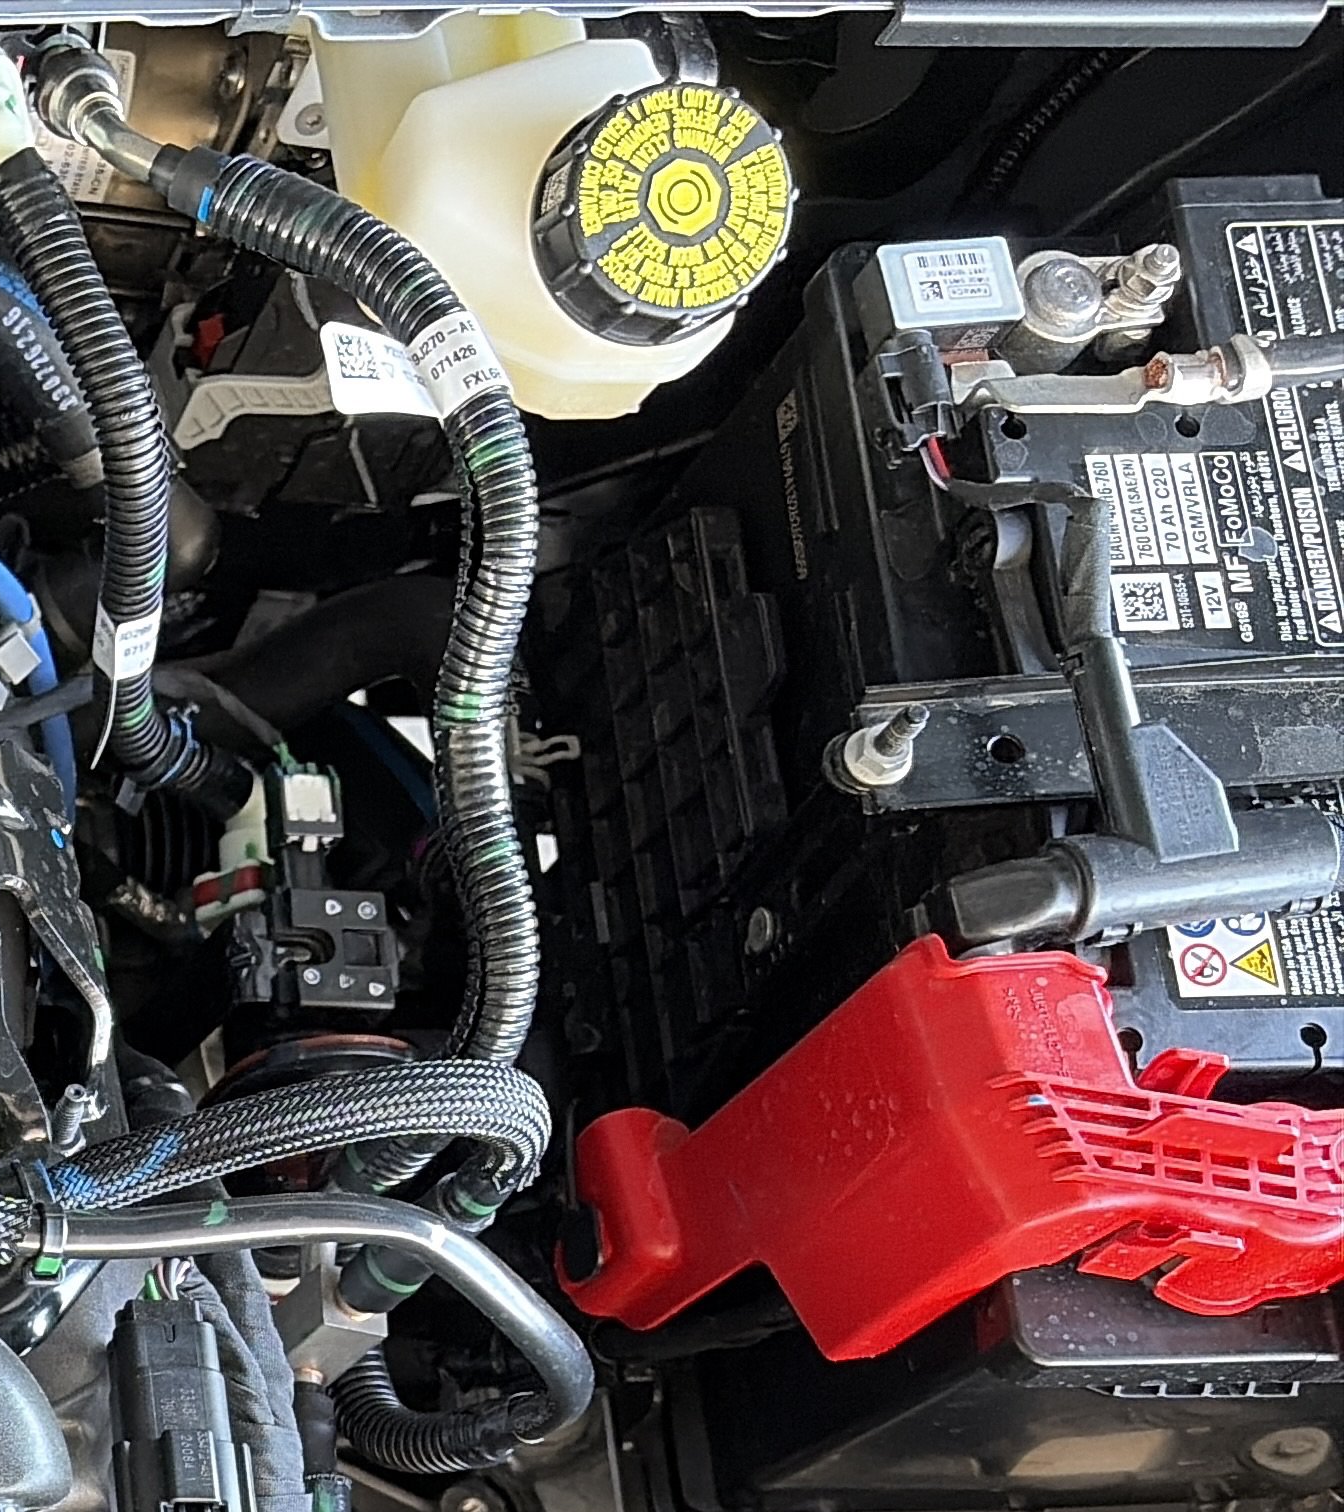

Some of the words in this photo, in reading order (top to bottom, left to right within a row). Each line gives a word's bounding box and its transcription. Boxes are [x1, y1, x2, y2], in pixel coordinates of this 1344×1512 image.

[641, 90, 678, 115] FROM
[682, 88, 720, 113] FLUID
[629, 133, 670, 172] CLEAN
[603, 159, 626, 187] USE
[430, 344, 477, 380] 071426
[1120, 459, 1141, 503] (SAE/EN)
[1154, 467, 1170, 498] C20
[1260, 480, 1274, 493] MI
[1178, 462, 1211, 555] AGM/VRLA
[1213, 456, 1245, 544] FoMoCo
[1133, 506, 1149, 533] CCA
[1161, 504, 1176, 527] Ah
[1139, 535, 1155, 560] 760
[1165, 530, 1181, 552] 70
[1292, 488, 1337, 611] DANGER/POISON
[1224, 555, 1254, 593] MF
[1202, 584, 1223, 615] 12V
[1286, 591, 1303, 617] Motor
[1276, 621, 1293, 642] Dist.
[1292, 619, 1309, 641] Ford
[1281, 938, 1294, 959] USA
